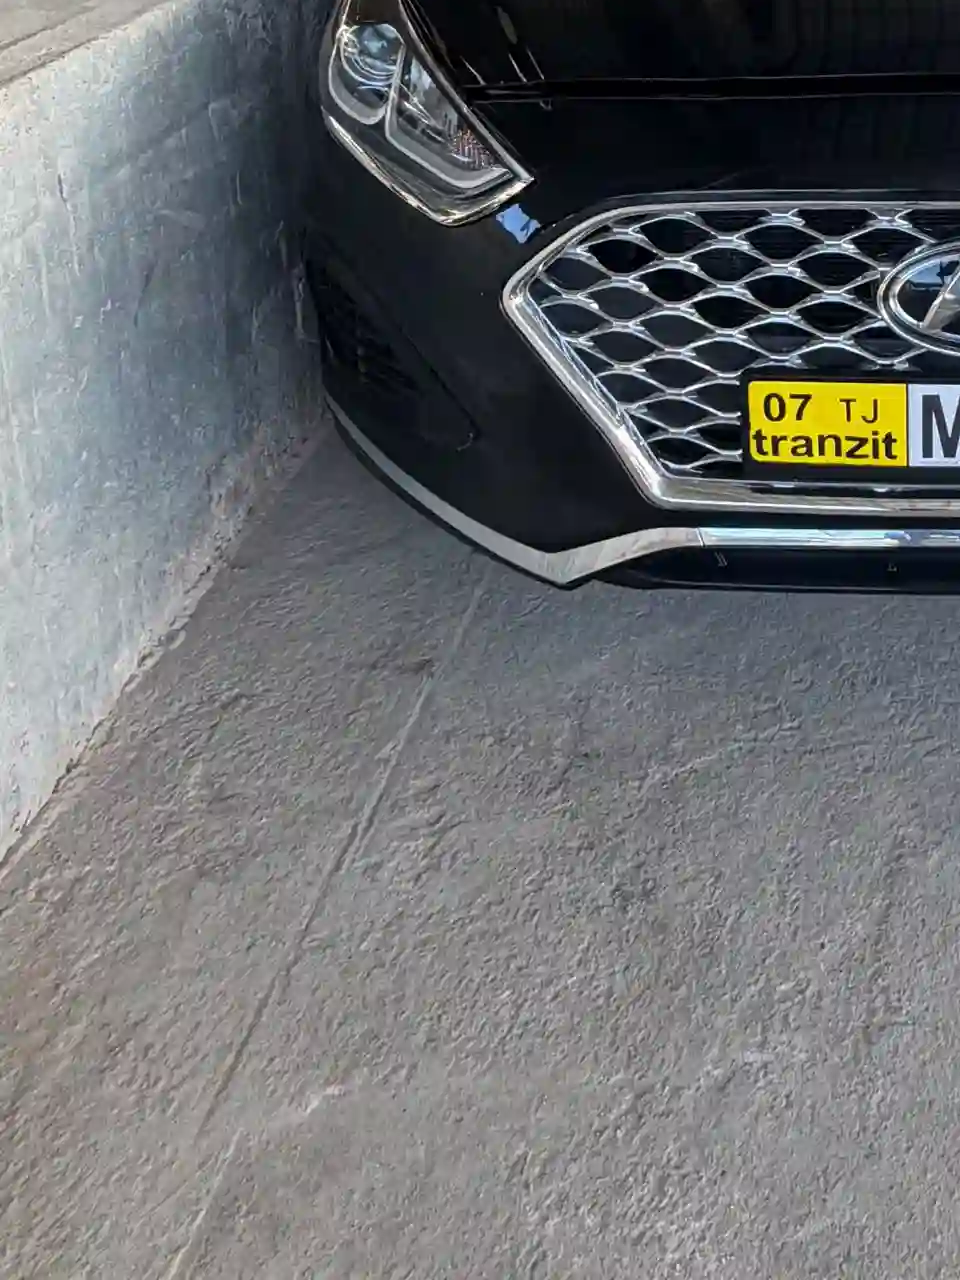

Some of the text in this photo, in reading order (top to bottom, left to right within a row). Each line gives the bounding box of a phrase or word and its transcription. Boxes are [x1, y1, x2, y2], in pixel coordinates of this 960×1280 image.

[763, 392, 878, 424] 07 TJ
[752, 429, 898, 460] tranzit
